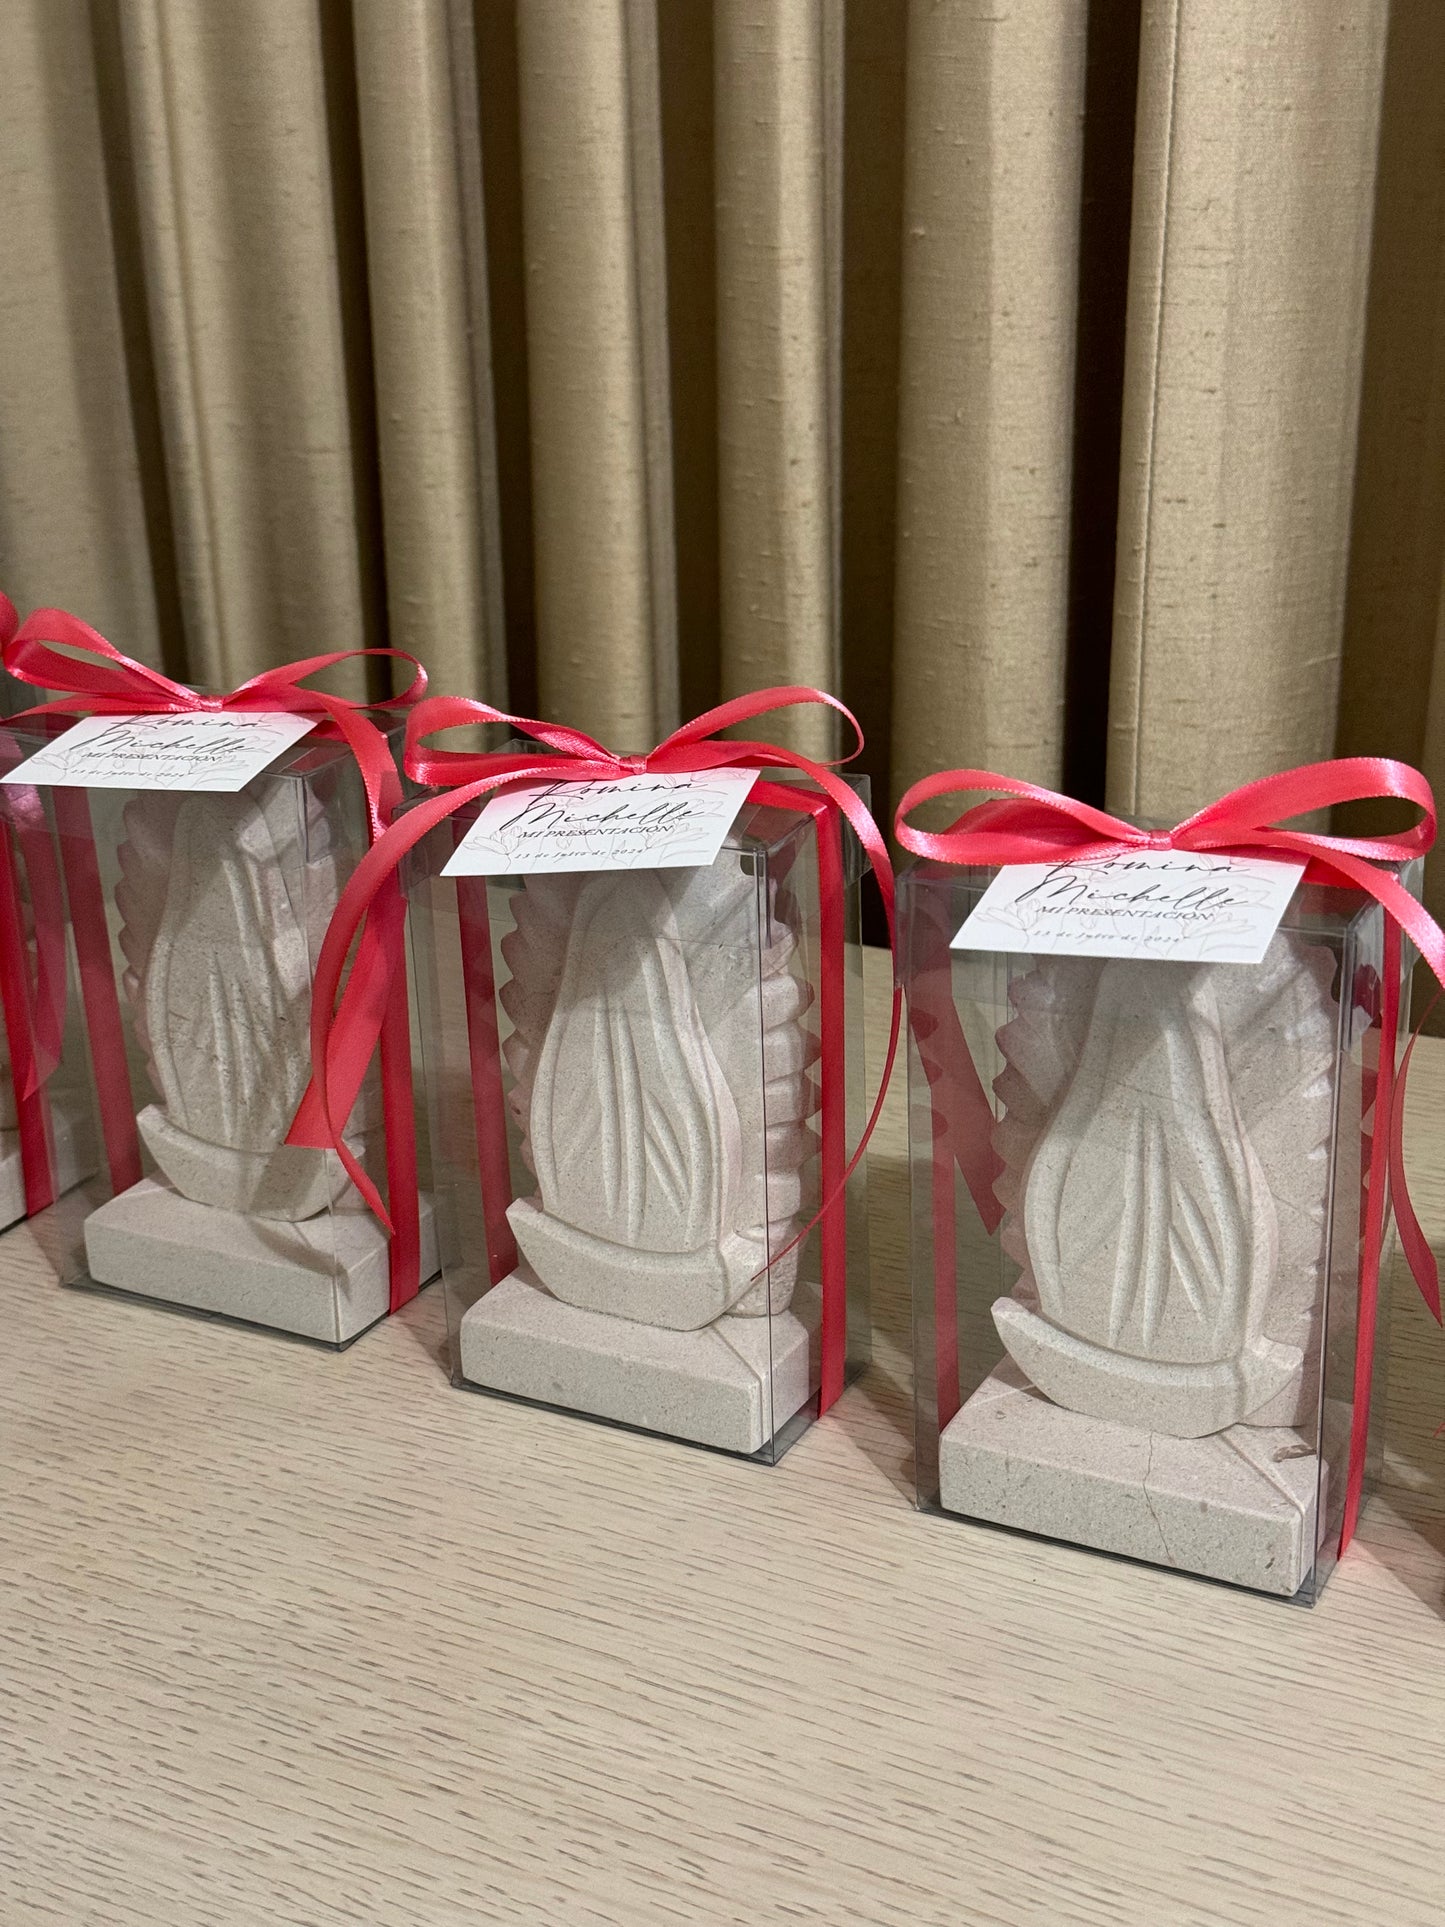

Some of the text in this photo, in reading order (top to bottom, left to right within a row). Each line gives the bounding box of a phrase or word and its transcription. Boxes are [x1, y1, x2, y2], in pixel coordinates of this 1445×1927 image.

[69, 730, 253, 755] Michelle
[500, 802, 705, 830] Michelle
[518, 830, 544, 838] MI
[1015, 875, 1249, 911] Michelle
[1036, 906, 1066, 914] MI
